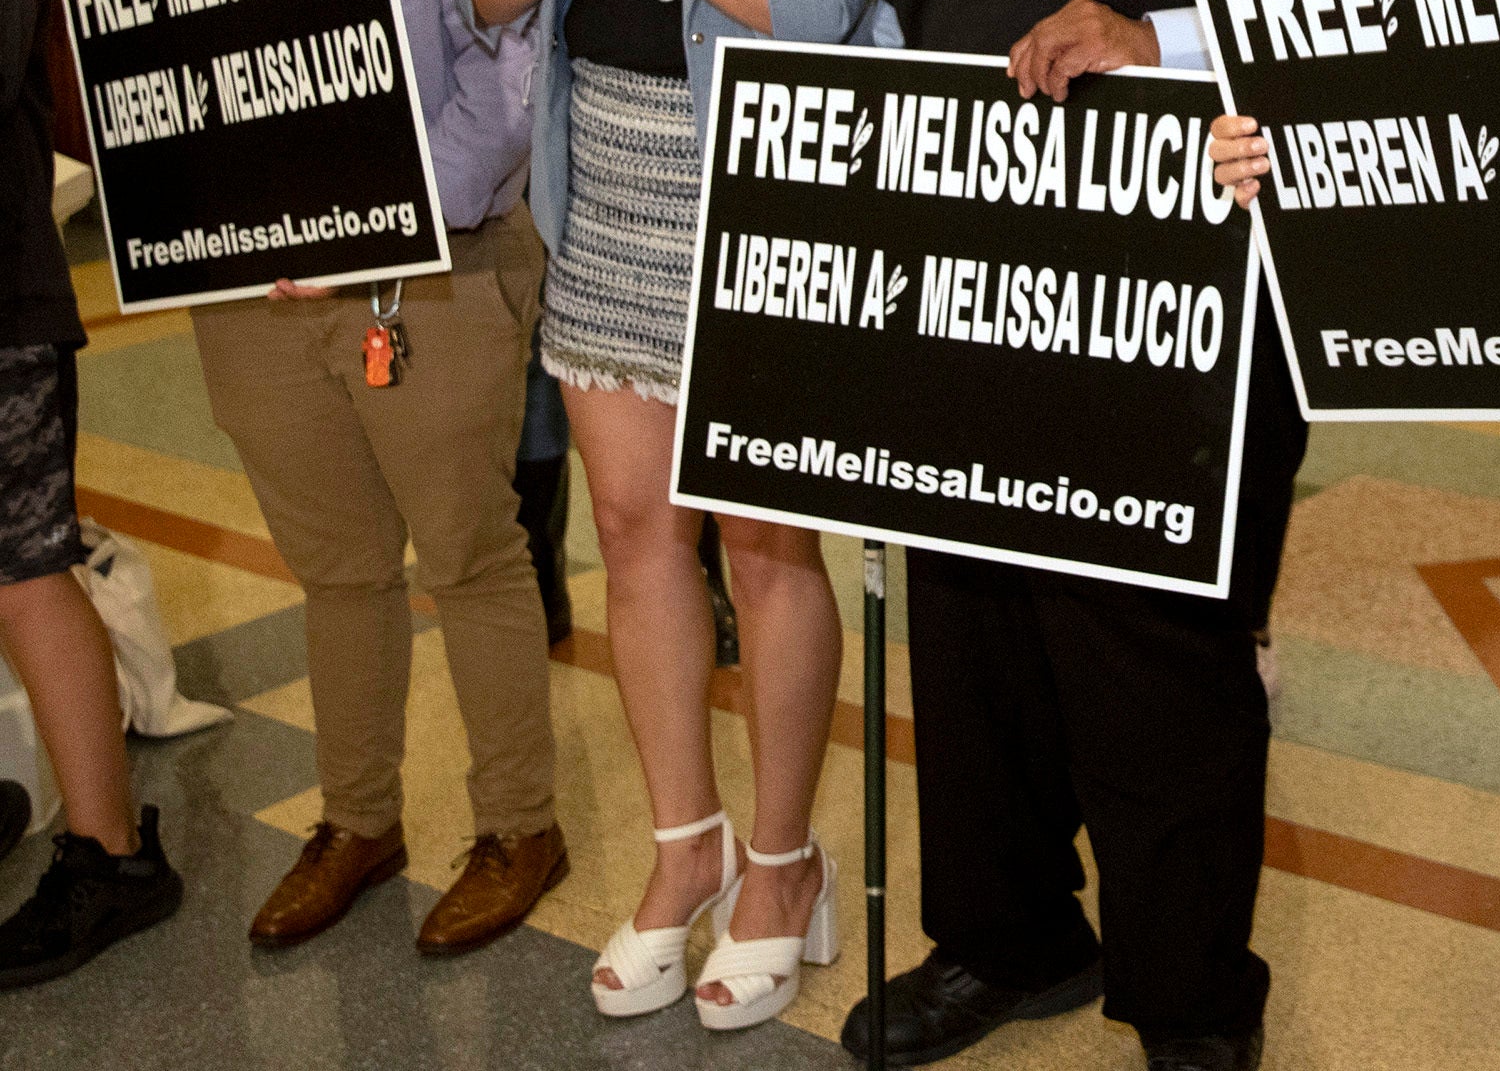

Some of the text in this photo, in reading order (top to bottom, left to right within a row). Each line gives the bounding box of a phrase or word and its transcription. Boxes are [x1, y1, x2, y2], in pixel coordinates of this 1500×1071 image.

[94, 19, 395, 150] LIBEREN A MELISSA LUCIO
[726, 80, 855, 187] FREE
[876, 93, 1068, 209] MELISSA
[1260, 115, 1446, 212] LIBEREN
[1448, 113, 1488, 203] A
[126, 201, 418, 271] FreeMelissaLucio.org
[713, 230, 1225, 374] LIBEREN A MELISSA LUCIO
[705, 422, 1196, 546] FreeMelissaLucio.org
